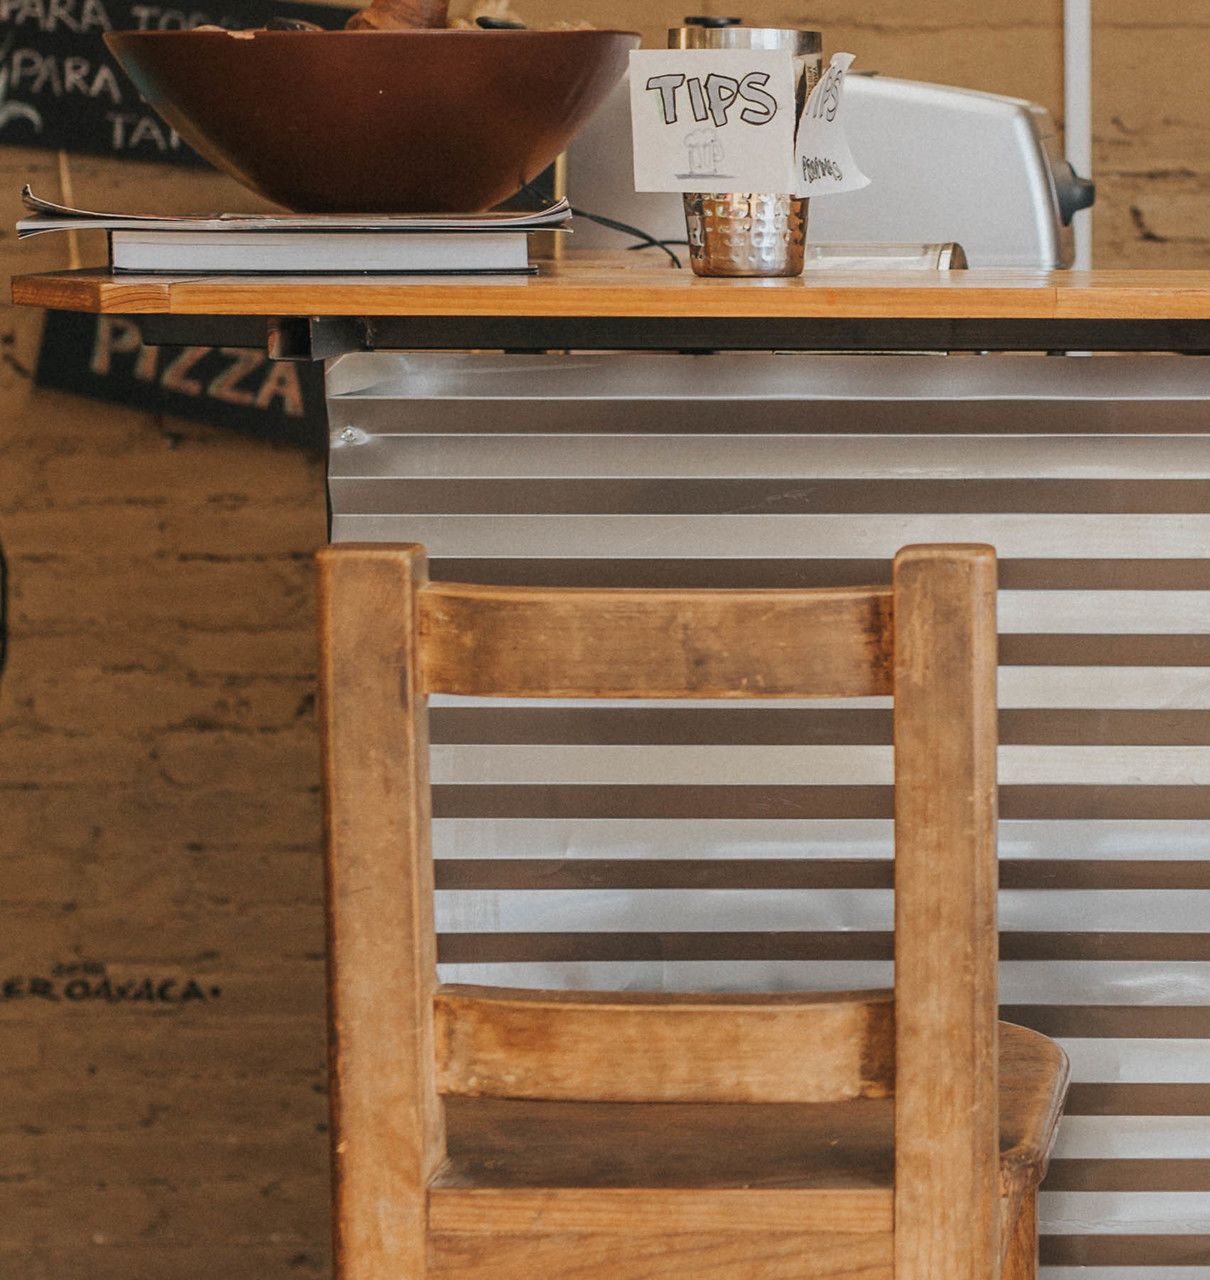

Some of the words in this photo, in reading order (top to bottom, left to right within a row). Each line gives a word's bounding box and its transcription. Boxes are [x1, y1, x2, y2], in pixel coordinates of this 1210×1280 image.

[9, 48, 123, 104] PARA
[646, 71, 777, 127] TIPS
[89, 315, 305, 418] PIZZA
